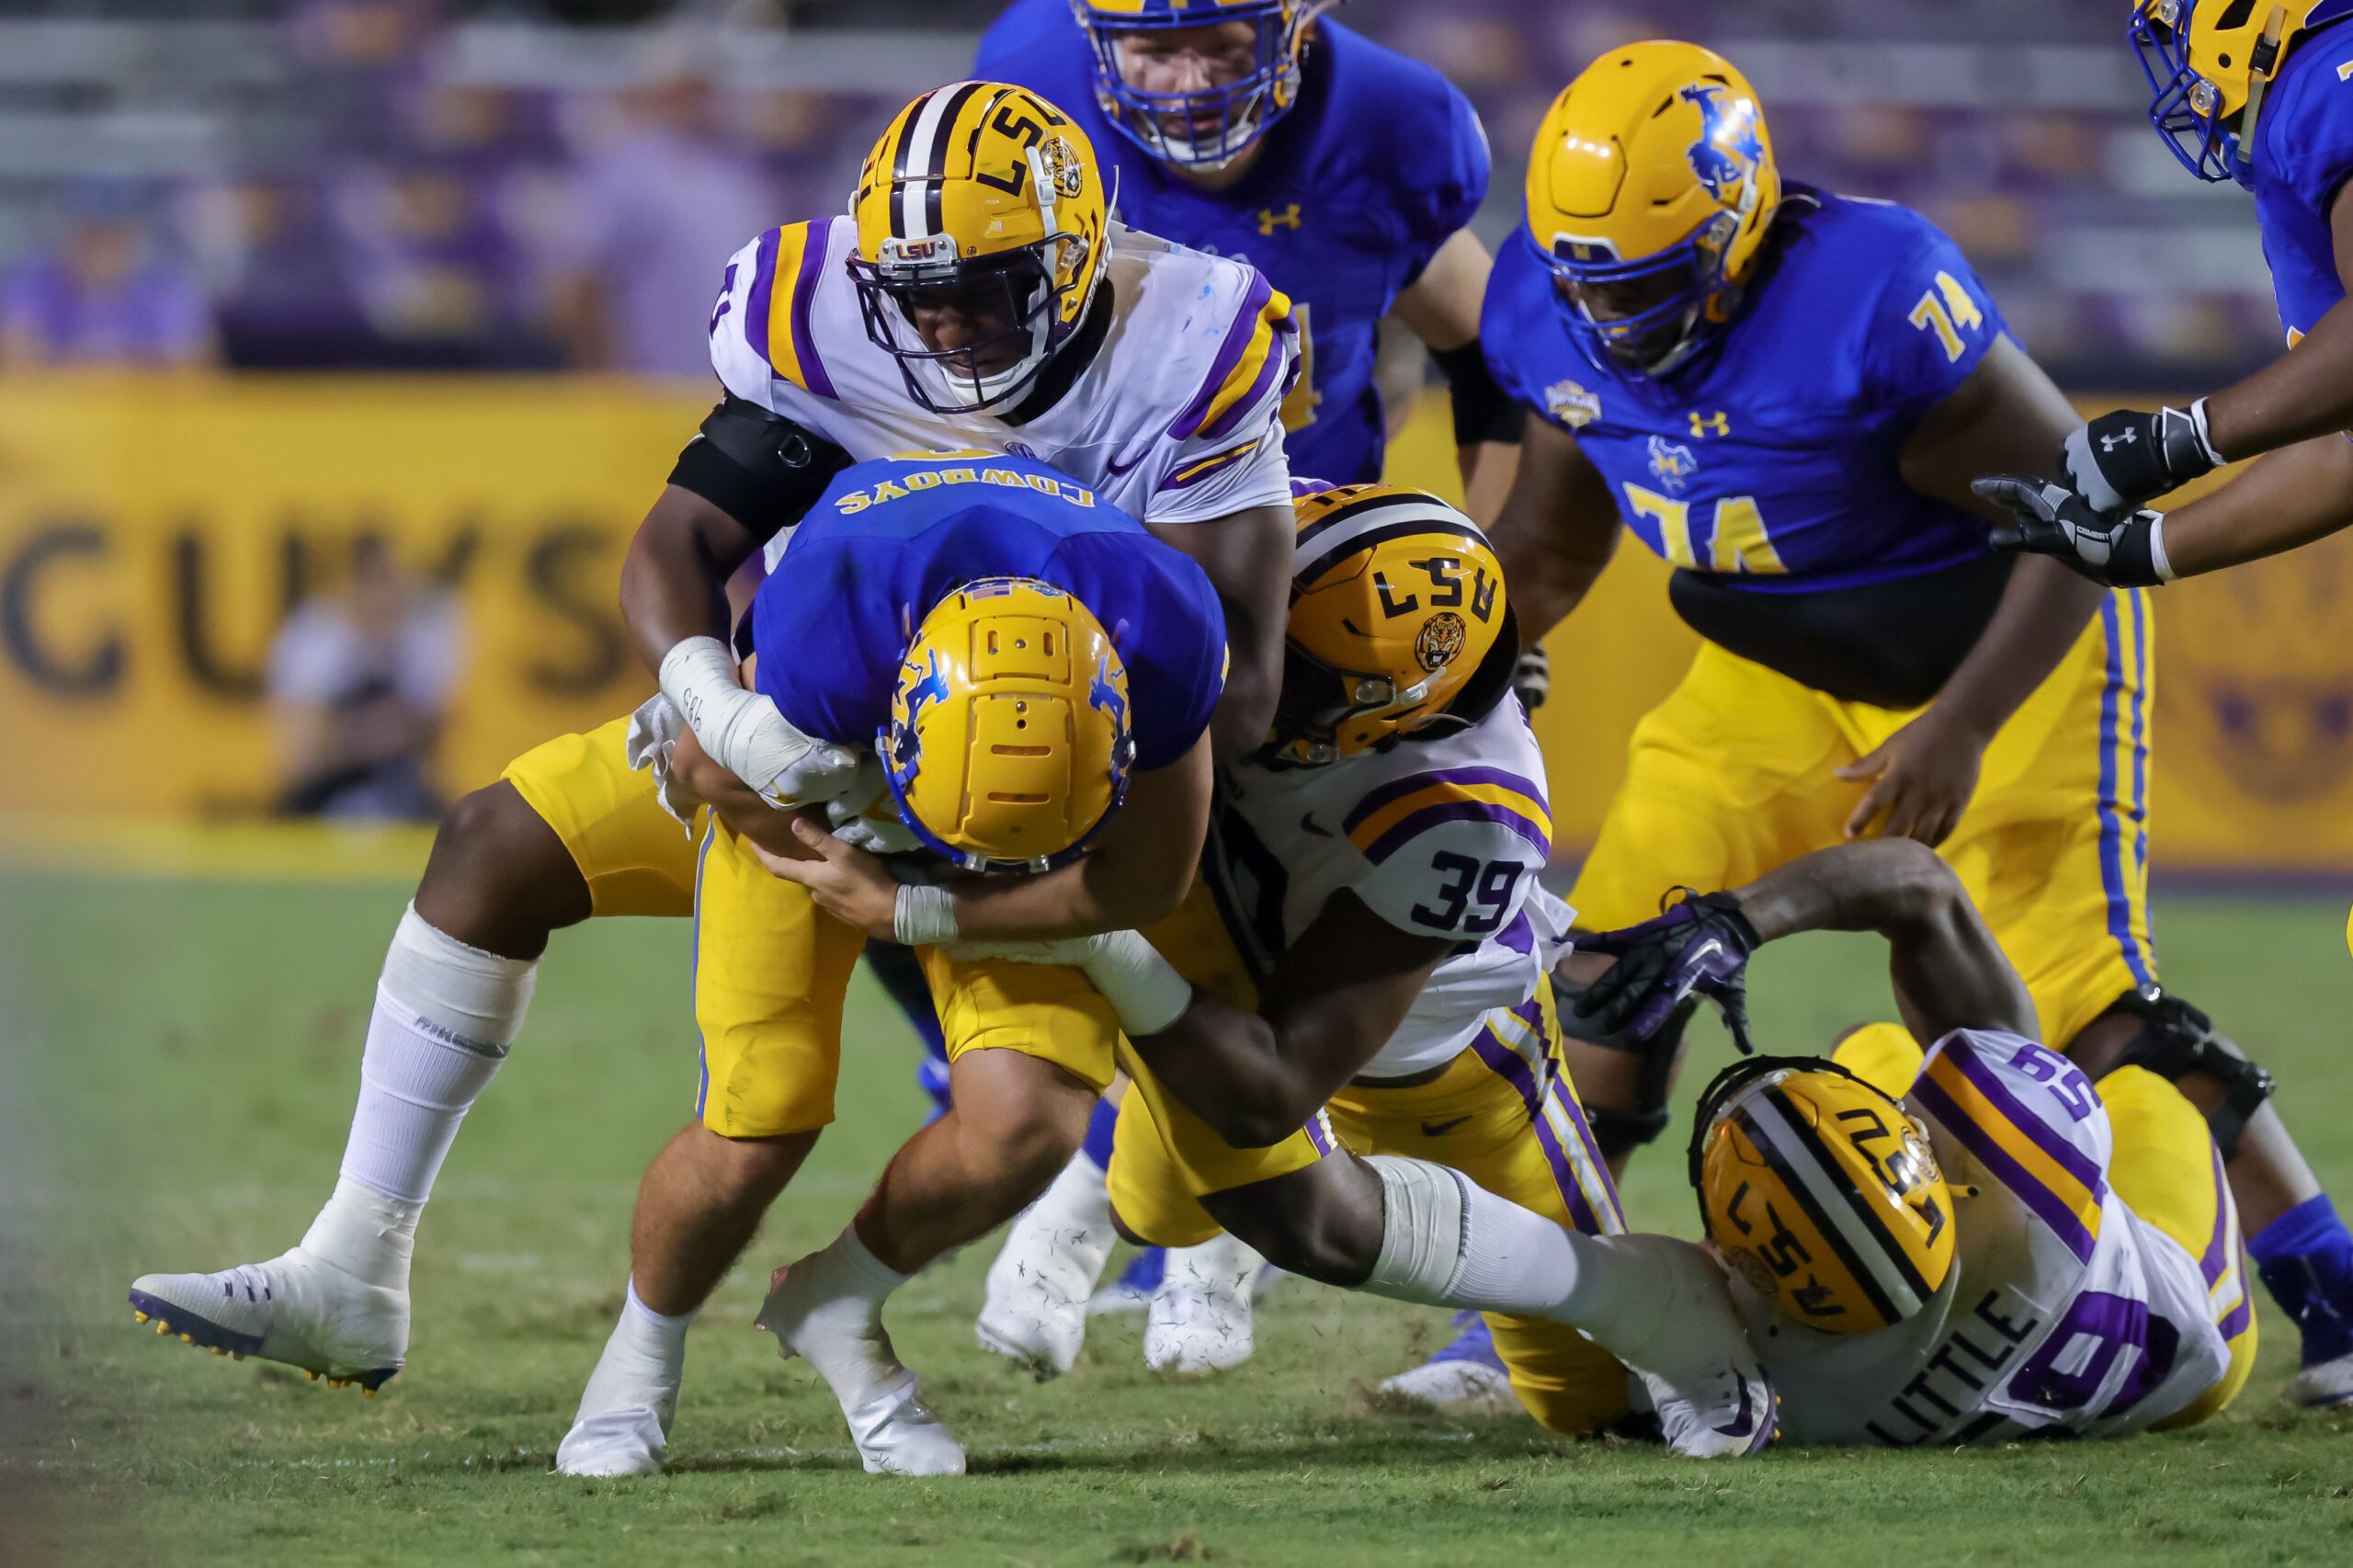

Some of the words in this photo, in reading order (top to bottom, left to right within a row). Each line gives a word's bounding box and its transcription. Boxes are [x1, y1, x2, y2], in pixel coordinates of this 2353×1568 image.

[976, 94, 1067, 198] LSU
[895, 241, 936, 261] LSU
[1908, 269, 1984, 363] 74
[834, 468, 1097, 516] COWBOYS
[1623, 480, 1790, 574] 74
[2076, 525, 2109, 540] COMBAT
[1372, 557, 1498, 625] LSU
[1411, 849, 1524, 934] 39
[2009, 1043, 2103, 1123] 59
[1866, 1289, 2039, 1447] LITTLE
[1941, 1289, 2181, 1447] 9
